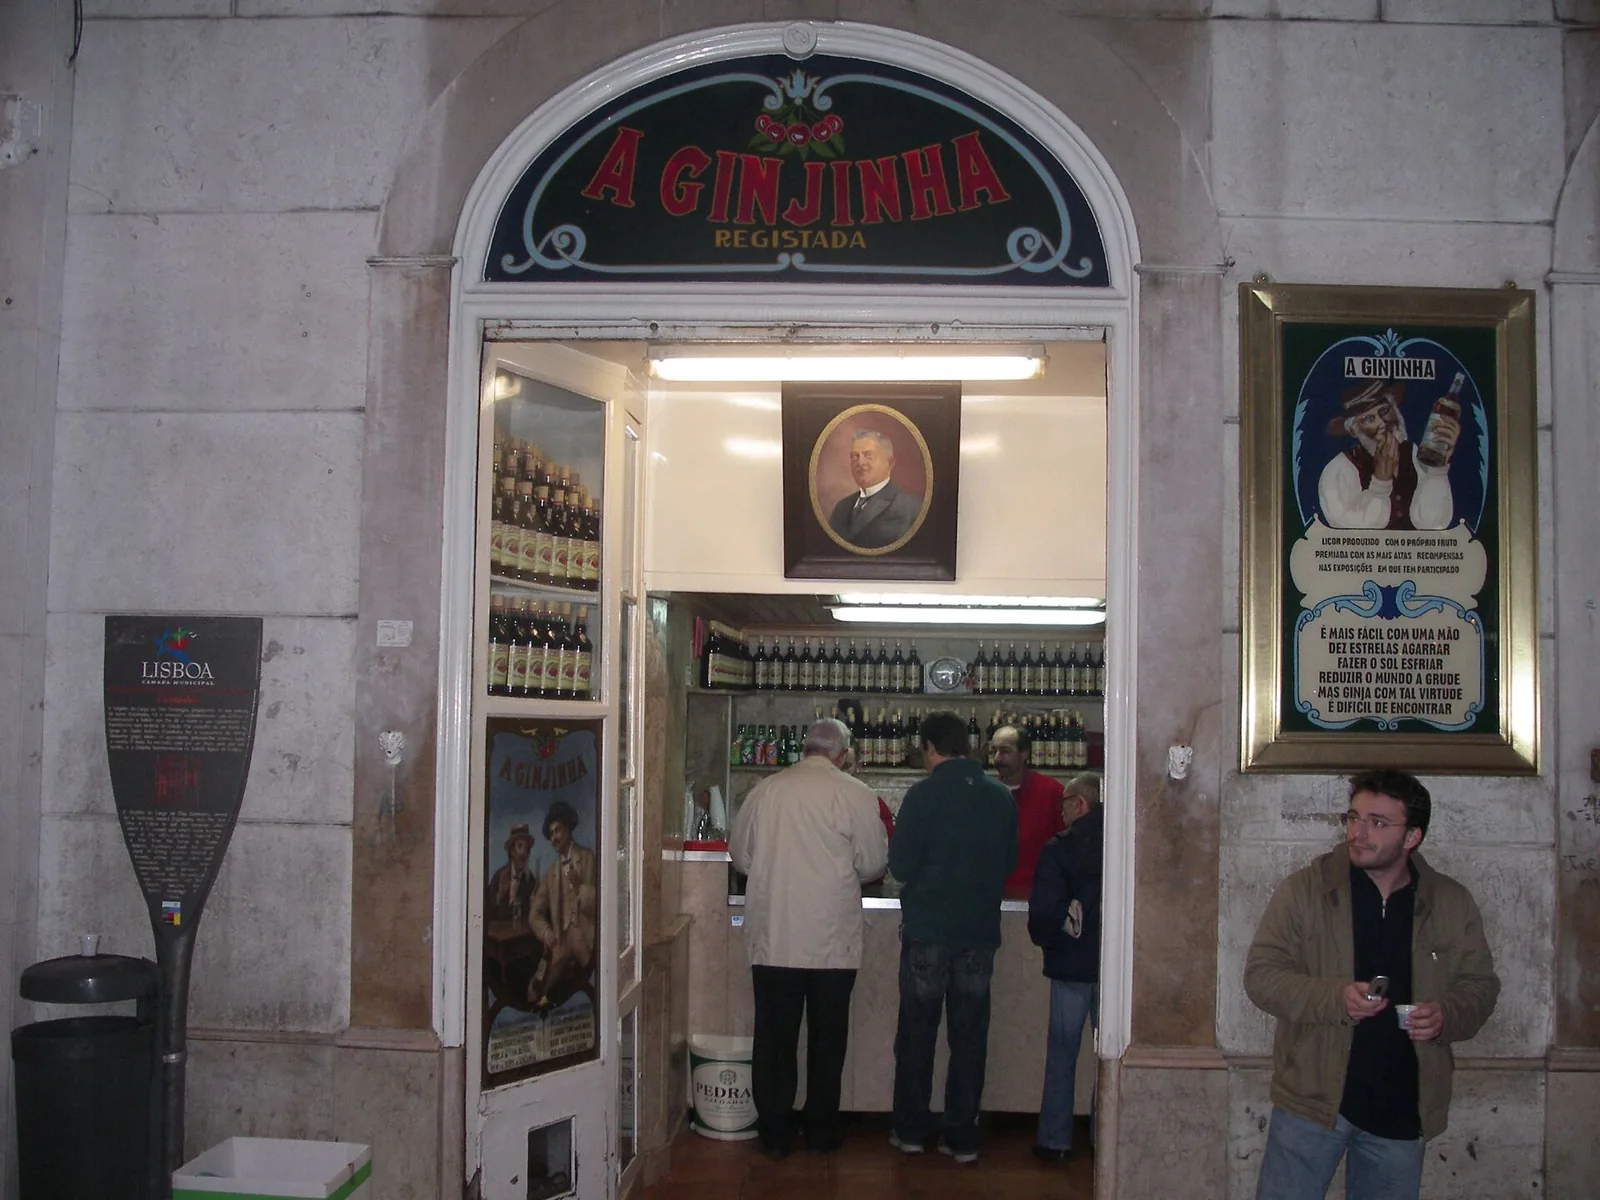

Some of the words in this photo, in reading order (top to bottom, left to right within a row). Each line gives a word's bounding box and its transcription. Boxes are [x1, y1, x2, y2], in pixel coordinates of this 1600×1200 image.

[581, 126, 644, 209] A
[660, 131, 1010, 226] GINJINHA
[714, 229, 867, 249] REGISTADA
[1346, 358, 1356, 376] A
[1361, 358, 1434, 378] GINJINHA
[1322, 538, 1341, 546] LICOR
[1342, 538, 1380, 546] PRODUZIDO
[1385, 538, 1399, 546] COM
[1400, 538, 1406, 546] O
[1407, 537, 1436, 546] PRÓPRIO
[1438, 539, 1458, 547] FRUTO
[1350, 551, 1364, 559] COM
[1366, 551, 1375, 559] AS
[1394, 552, 1412, 560] ALTAS
[1417, 552, 1464, 560] RECOMPENSAS
[1318, 564, 1332, 572] NAS
[1333, 563, 1372, 573] EXPOSIÇÕES
[1378, 565, 1387, 573] EM
[1417, 566, 1460, 574] PARTICIPADO
[1321, 625, 1326, 639] É
[1329, 628, 1354, 639] MAIS
[1358, 626, 1384, 640] FÁCIL
[1387, 628, 1409, 640] COM
[1412, 628, 1434, 640] UMA
[1438, 627, 1460, 640] MÃO
[1329, 642, 1347, 654] DEZ
[1350, 643, 1398, 654] ESTRELAS
[1402, 643, 1450, 655] AGARRAR
[142, 662, 215, 679] LISBOA
[1338, 657, 1367, 669] FAZER
[1370, 658, 1377, 669] O
[1380, 658, 1398, 670] SOL
[1401, 658, 1443, 670] ESFRIAR
[1319, 672, 1362, 683] REDUZIR
[1366, 672, 1372, 684] O
[1375, 672, 1412, 684] MUNDO
[1416, 673, 1422, 684] A
[1426, 673, 1460, 685] GRUDE
[1318, 686, 1340, 698] MAS
[1343, 686, 1371, 700] GINJA
[1374, 687, 1396, 699] COM
[1400, 688, 1416, 699] TAL
[1419, 688, 1462, 700] VIRTUDE
[1375, 702, 1388, 713] DE
[1391, 702, 1452, 715] ENCONTRAR
[499, 754, 512, 781] A
[515, 754, 588, 790] GINJINHA
[696, 1082, 751, 1098] PEDRA
